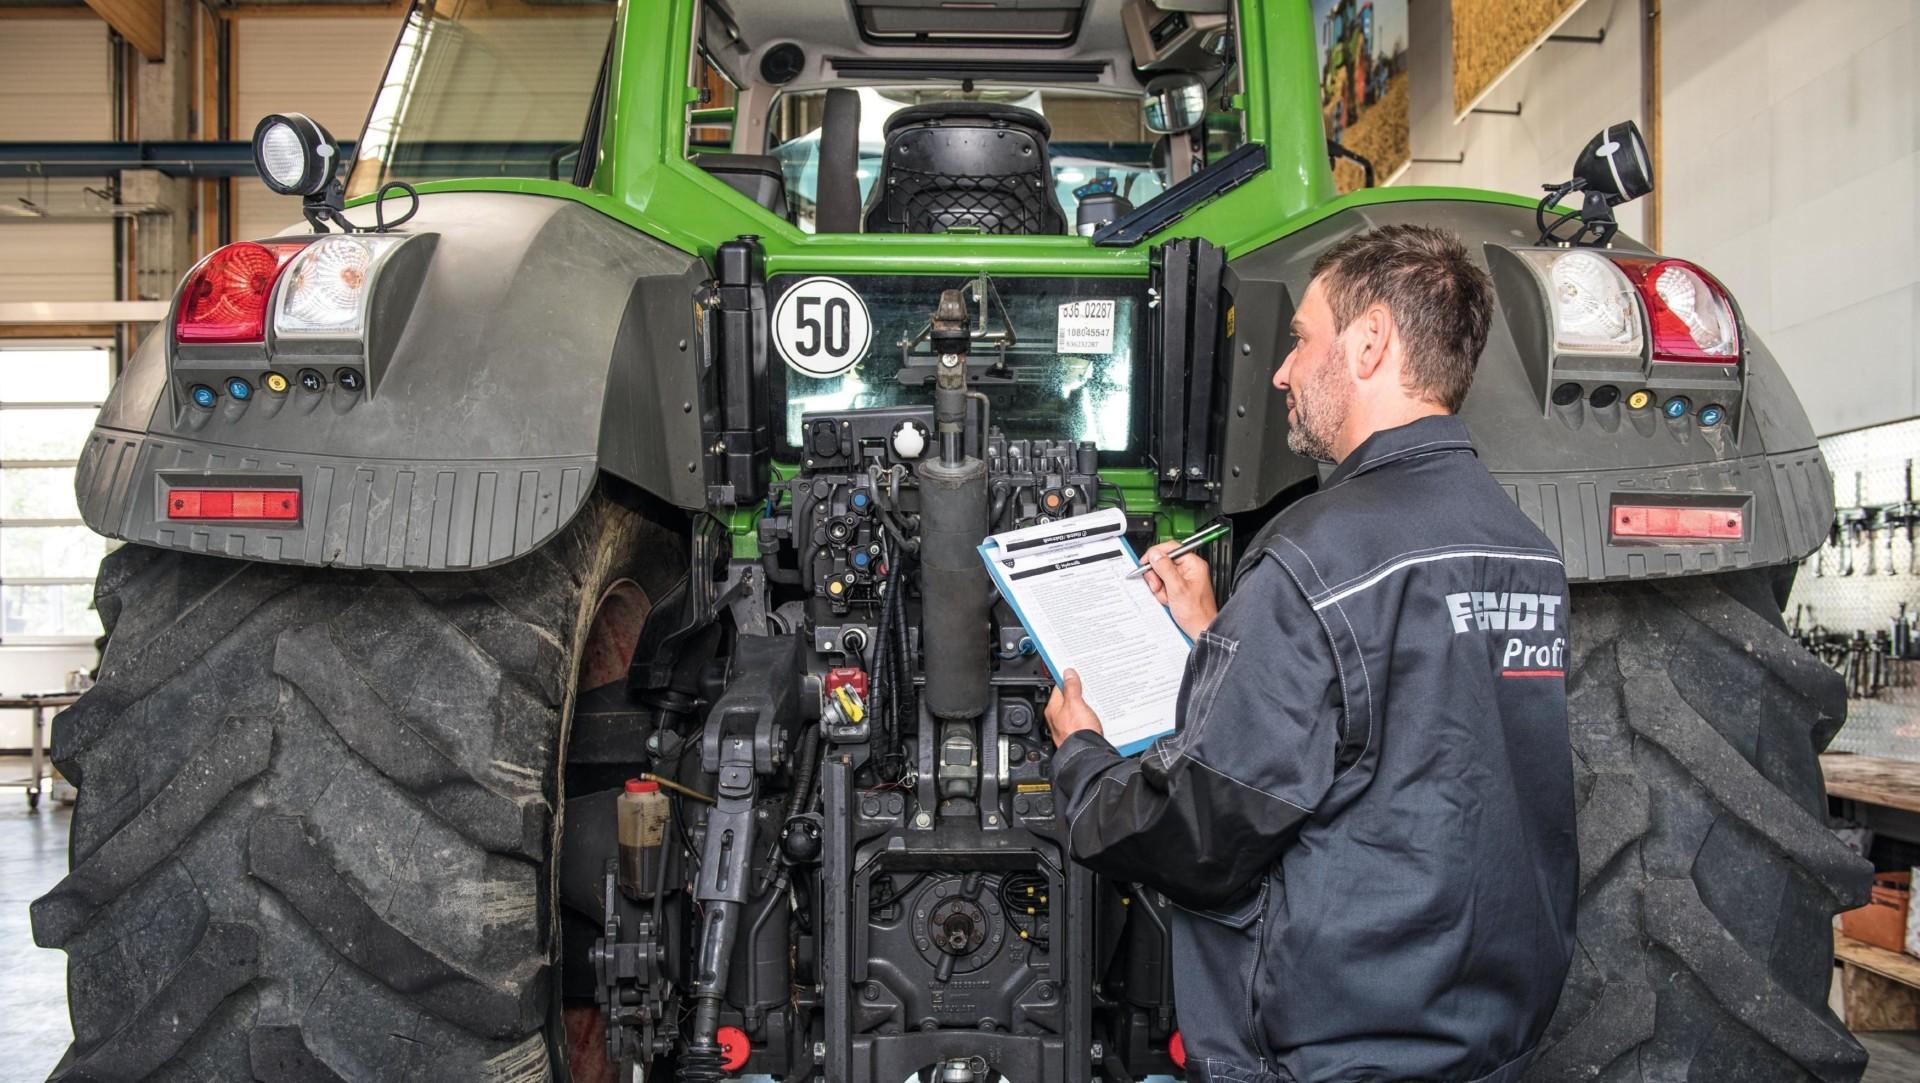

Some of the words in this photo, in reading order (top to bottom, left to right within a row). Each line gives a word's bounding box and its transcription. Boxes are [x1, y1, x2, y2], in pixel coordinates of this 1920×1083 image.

[796, 297, 850, 357] 50
[1445, 592, 1561, 633] FENDT
[1503, 637, 1565, 667] Profi
